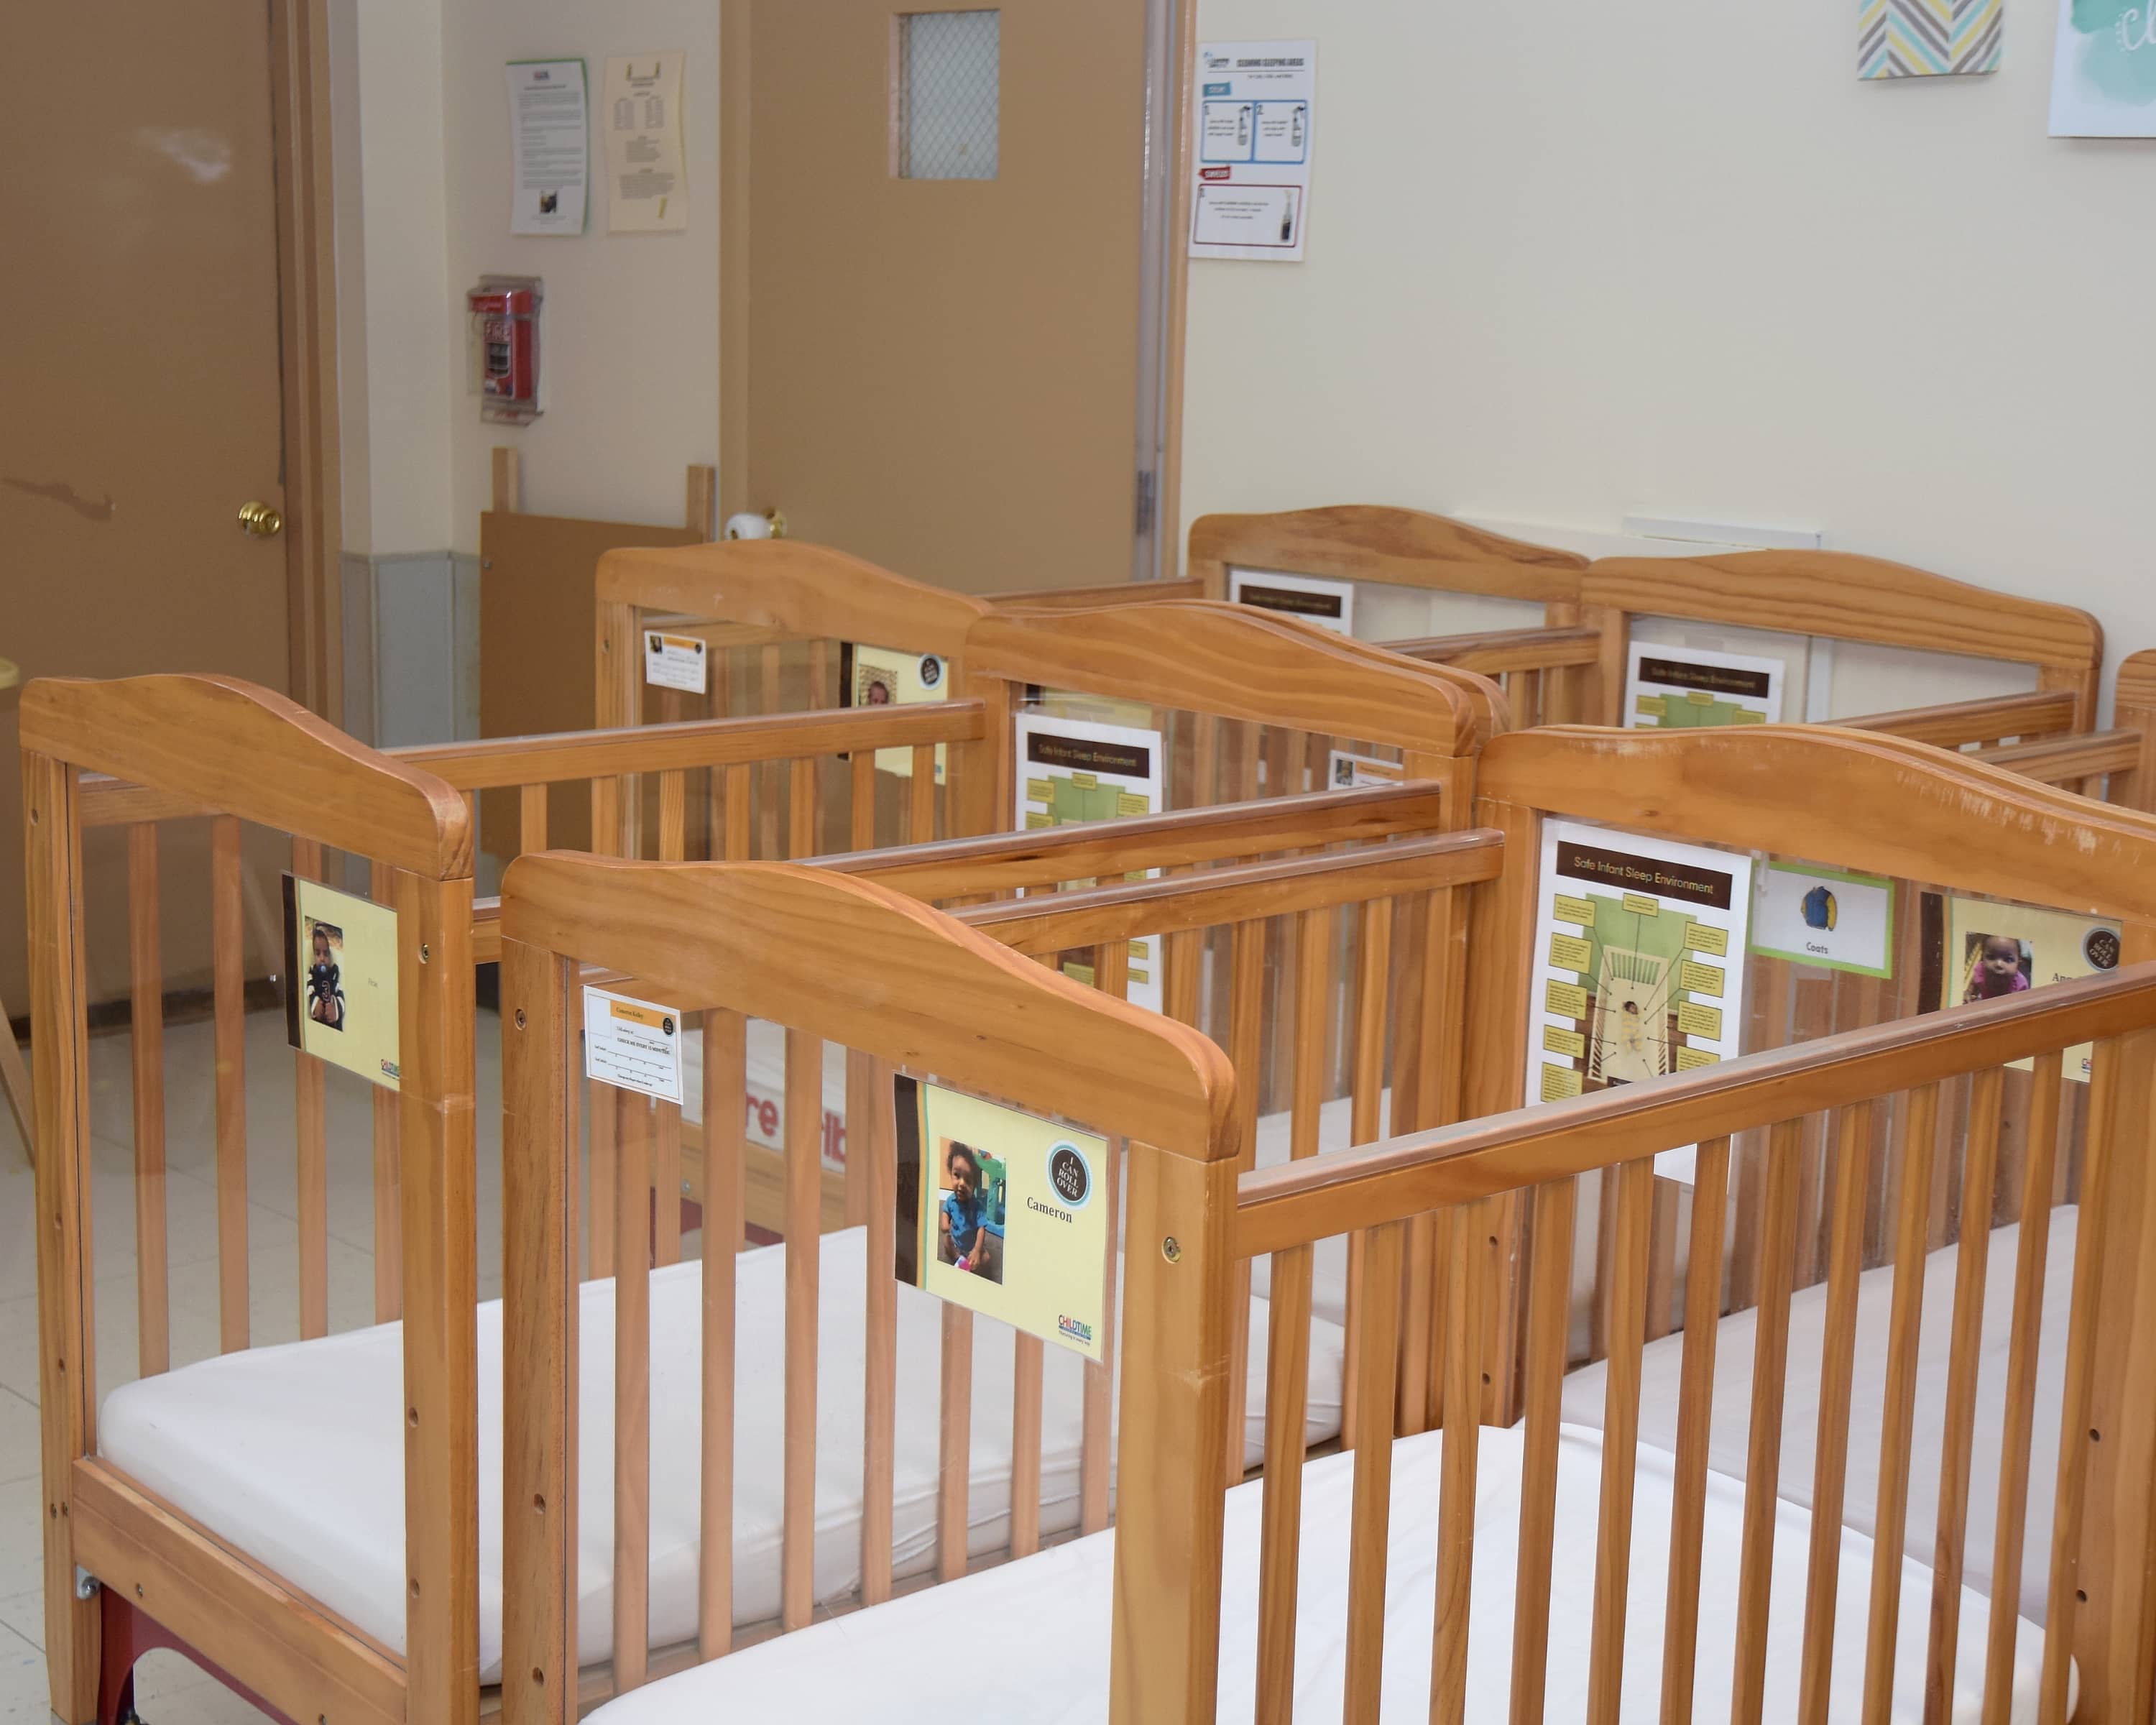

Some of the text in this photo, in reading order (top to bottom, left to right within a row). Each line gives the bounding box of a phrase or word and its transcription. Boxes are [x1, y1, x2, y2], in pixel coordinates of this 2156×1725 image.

[1574, 857, 1714, 894] Safe Infant Sleep Environment
[1806, 942, 1829, 954] Coats
[1062, 1162, 1078, 1177] CAN
[1070, 1156, 1074, 1165] I
[1056, 1177, 1078, 1197] OVER
[1058, 1168, 1079, 1188] ROLL
[1027, 1197, 1072, 1223] Cameron
[1059, 1314, 1092, 1336] CHILDTIME
